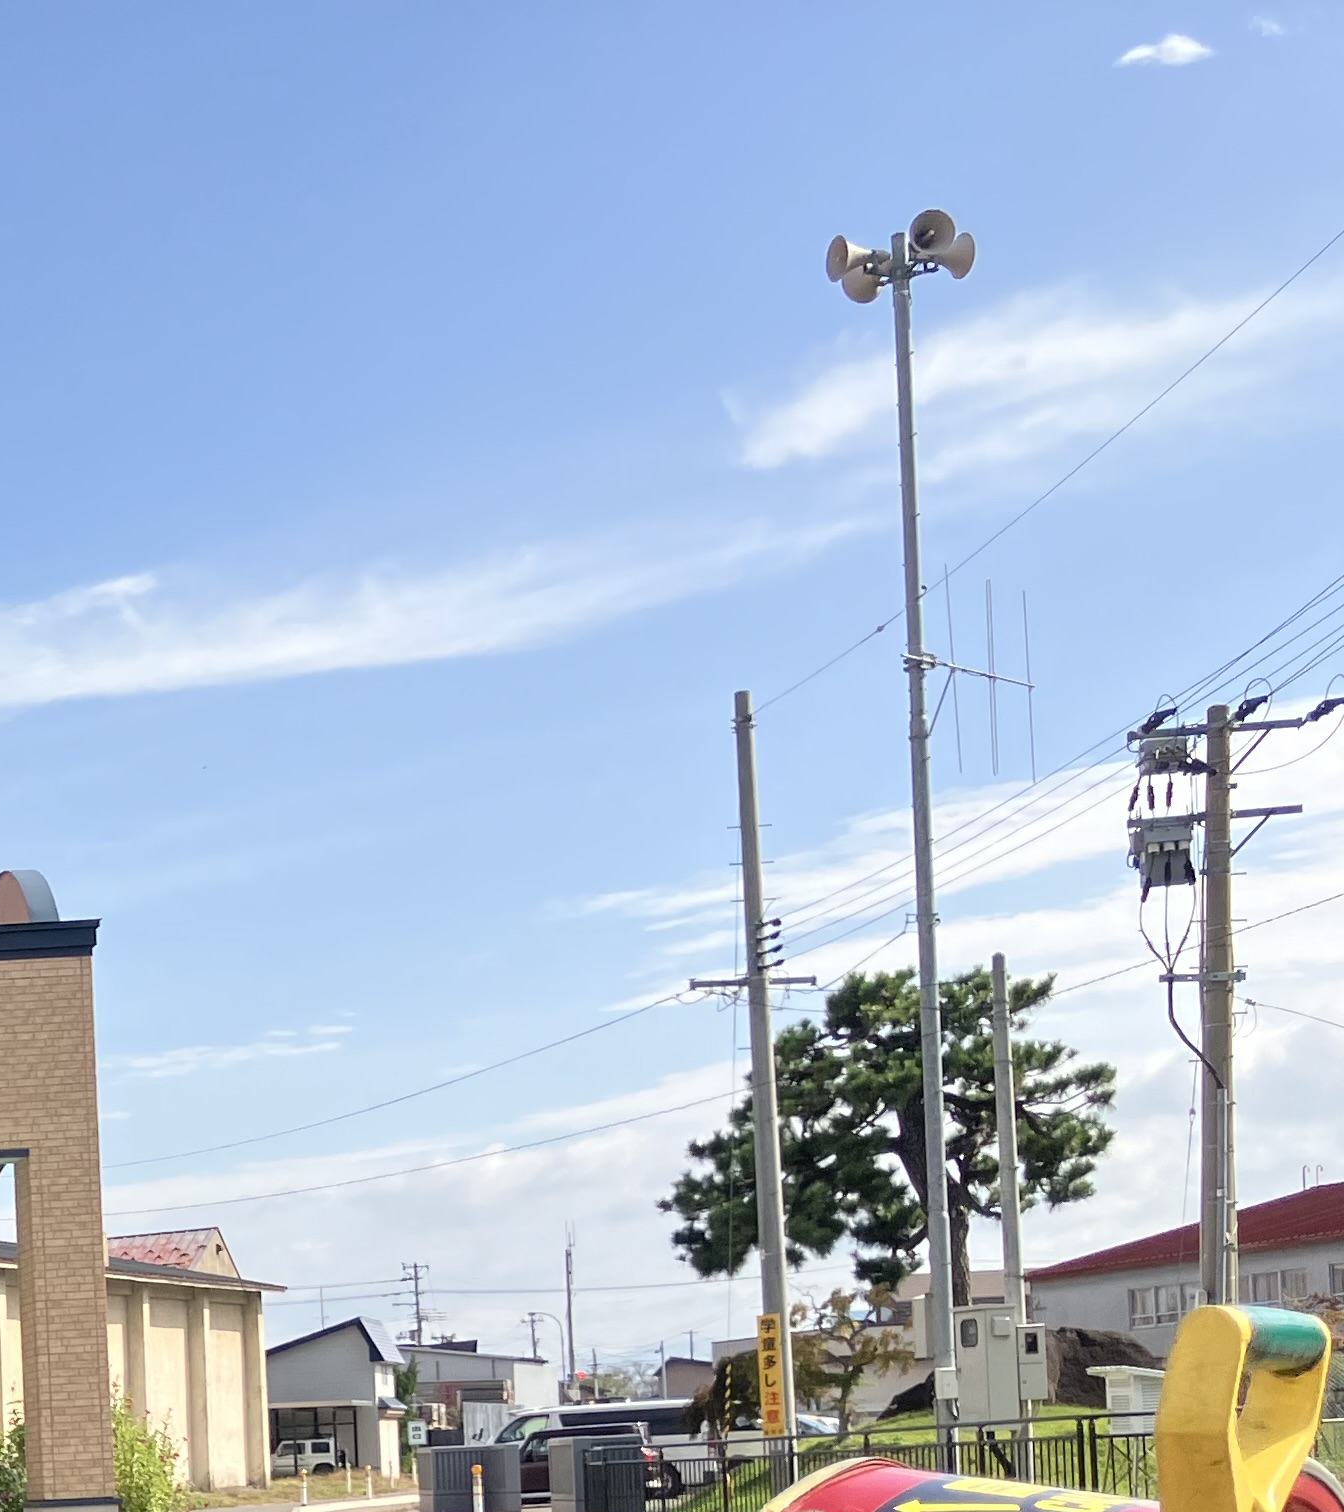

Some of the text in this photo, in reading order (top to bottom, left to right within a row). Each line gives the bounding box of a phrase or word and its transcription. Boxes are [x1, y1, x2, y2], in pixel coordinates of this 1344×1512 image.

[760, 1317, 780, 1424] 学童多し注意
